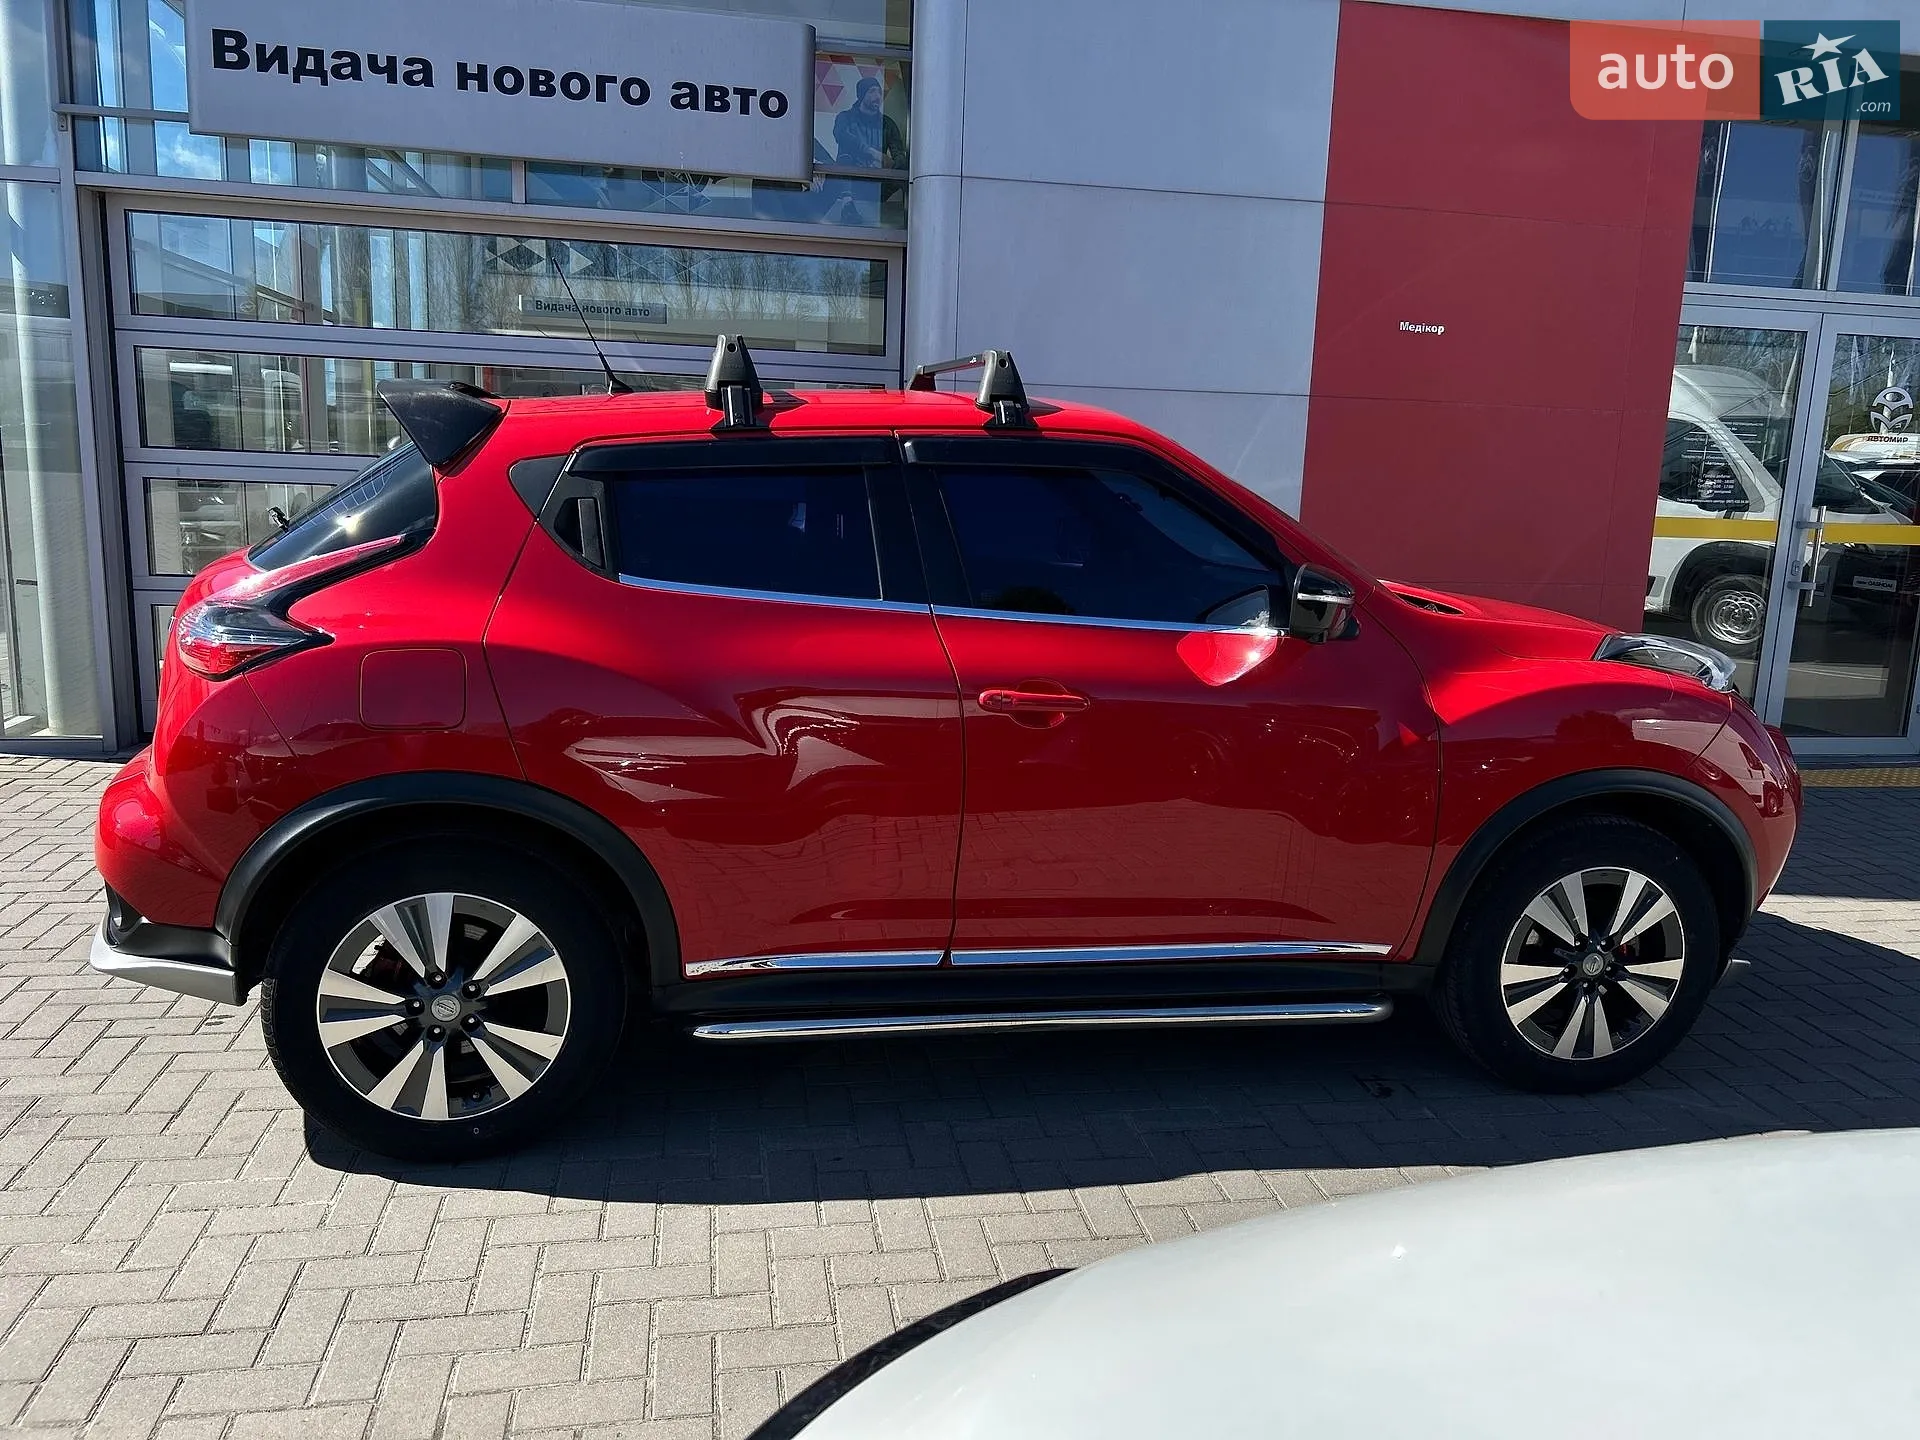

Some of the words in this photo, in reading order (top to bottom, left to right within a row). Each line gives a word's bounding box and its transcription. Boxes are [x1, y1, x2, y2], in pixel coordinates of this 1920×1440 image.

[211, 28, 435, 87] Видача
[456, 61, 651, 107] нового
[669, 81, 789, 119] авто
[535, 300, 578, 312] Видача
[582, 304, 622, 315] нового
[624, 307, 650, 317] авто
[1399, 321, 1445, 336] Медікор
